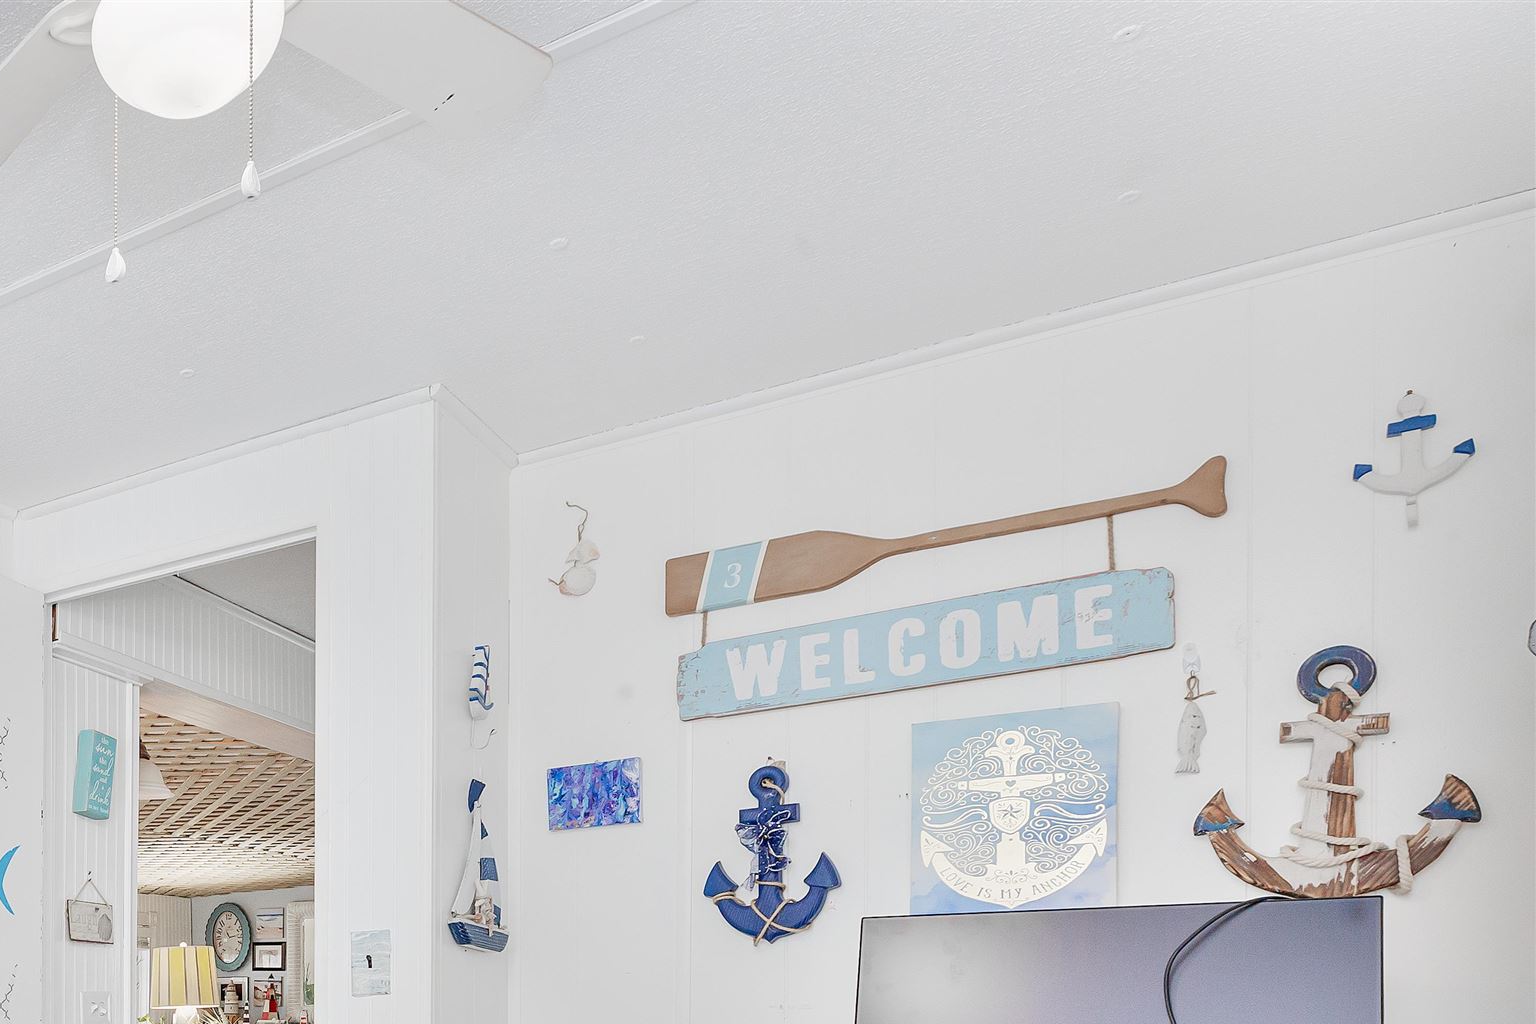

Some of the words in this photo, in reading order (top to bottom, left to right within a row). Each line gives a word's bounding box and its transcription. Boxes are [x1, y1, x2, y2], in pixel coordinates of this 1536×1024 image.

[722, 562, 743, 589] 3
[725, 584, 1114, 702] WELCOME
[940, 867, 973, 894] LOVE
[977, 887, 992, 898] IS
[1031, 859, 1085, 896] ANCHOR
